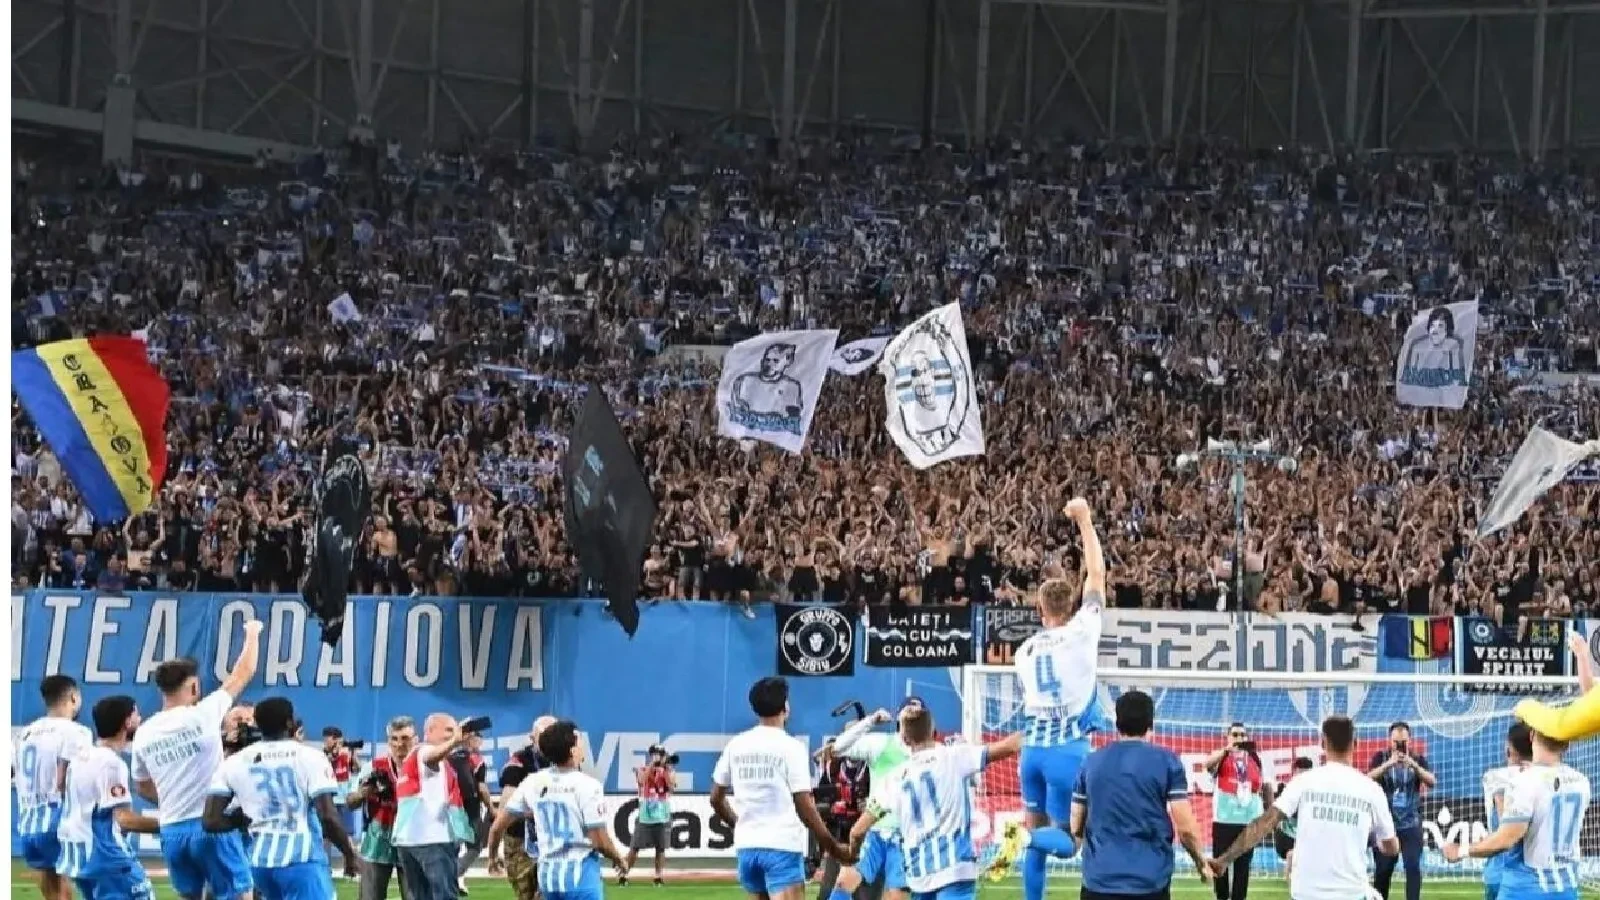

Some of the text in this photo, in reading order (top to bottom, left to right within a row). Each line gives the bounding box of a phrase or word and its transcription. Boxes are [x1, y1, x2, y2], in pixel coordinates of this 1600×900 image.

[909, 629, 931, 642] CU
[1035, 653, 1063, 703] 4
[1482, 661, 1545, 676] SPIRIT
[22, 743, 37, 793] 9
[1551, 791, 1583, 847] 17
